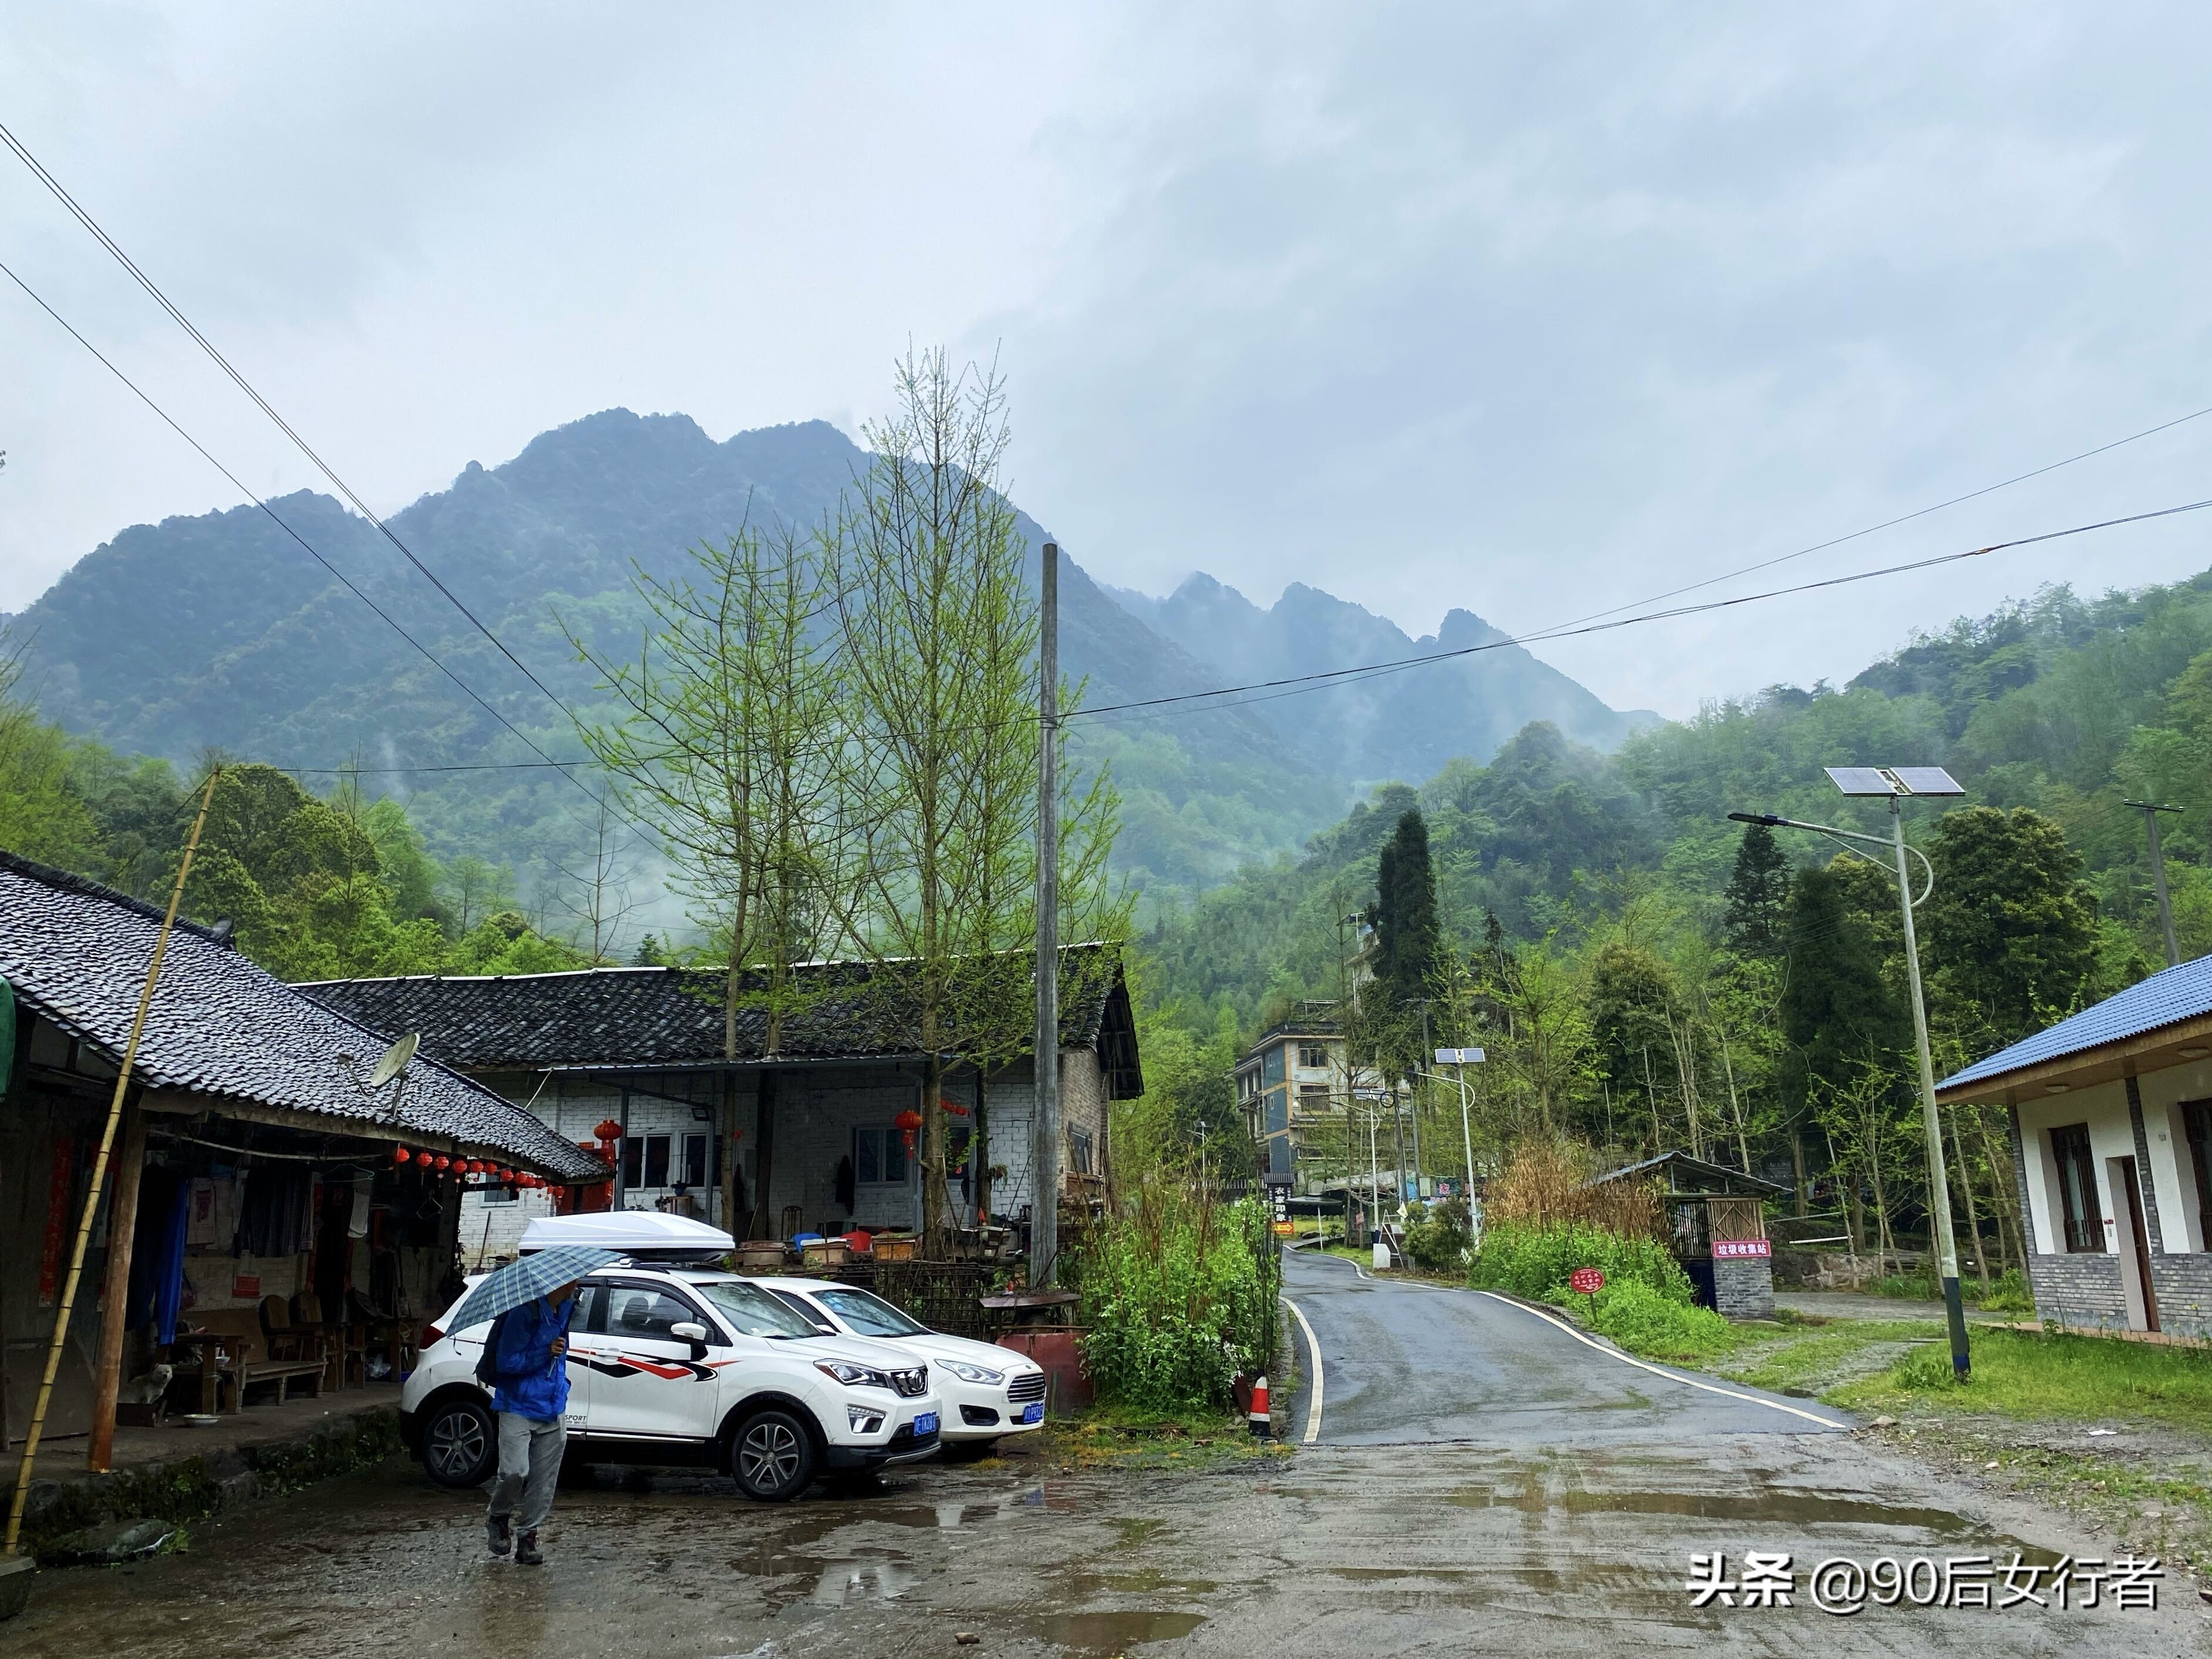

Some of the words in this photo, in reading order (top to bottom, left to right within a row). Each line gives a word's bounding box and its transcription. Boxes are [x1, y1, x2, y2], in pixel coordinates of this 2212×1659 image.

[1274, 1187, 1286, 1222] 农家印象
[1718, 1244, 1767, 1255] 垃圾收集站
